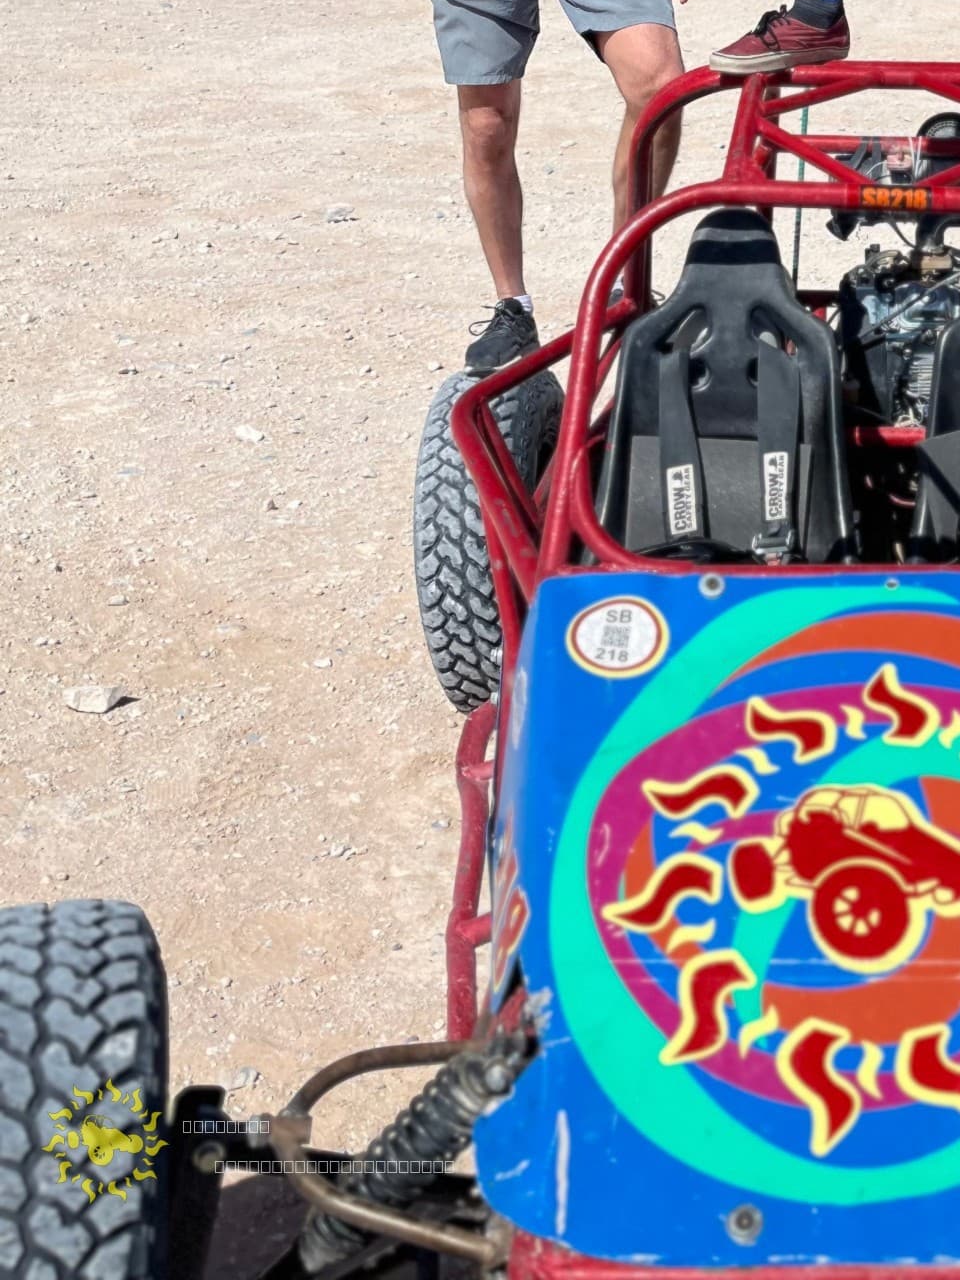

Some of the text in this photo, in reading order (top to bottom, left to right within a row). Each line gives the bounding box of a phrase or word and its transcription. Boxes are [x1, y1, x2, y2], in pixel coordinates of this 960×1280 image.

[672, 487, 687, 531] CROW
[683, 494, 692, 529] SAFETY
[768, 473, 779, 518] CROW
[606, 609, 632, 623] SB
[595, 647, 629, 662] 218
